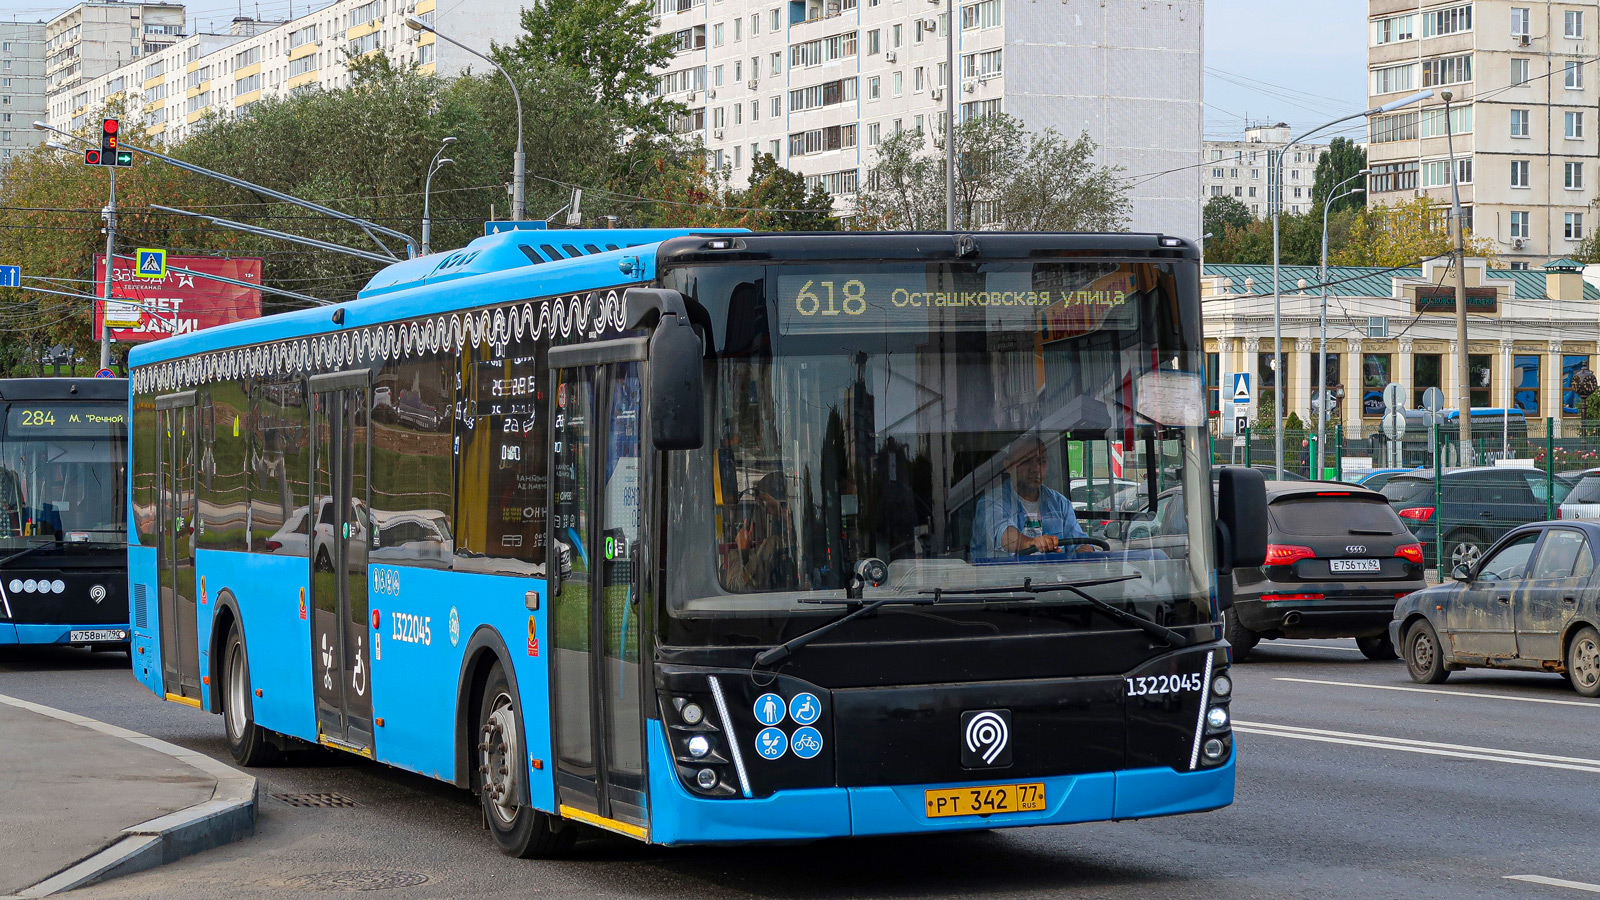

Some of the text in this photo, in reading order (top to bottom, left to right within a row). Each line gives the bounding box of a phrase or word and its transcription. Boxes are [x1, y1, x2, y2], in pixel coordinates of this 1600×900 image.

[142, 297, 183, 313] ЛЕТ
[795, 279, 867, 316] 618
[891, 288, 1125, 308] Осташковская улица
[22, 410, 56, 426] 284
[68, 414, 124, 423] М. "Речной
[1334, 560, 1367, 570] Е756ТХ
[73, 631, 107, 640] Х758ВН
[391, 611, 432, 646] 1322045
[1126, 673, 1202, 696] 1322045
[936, 789, 1008, 813] РТ 342
[1018, 786, 1038, 802] 77
